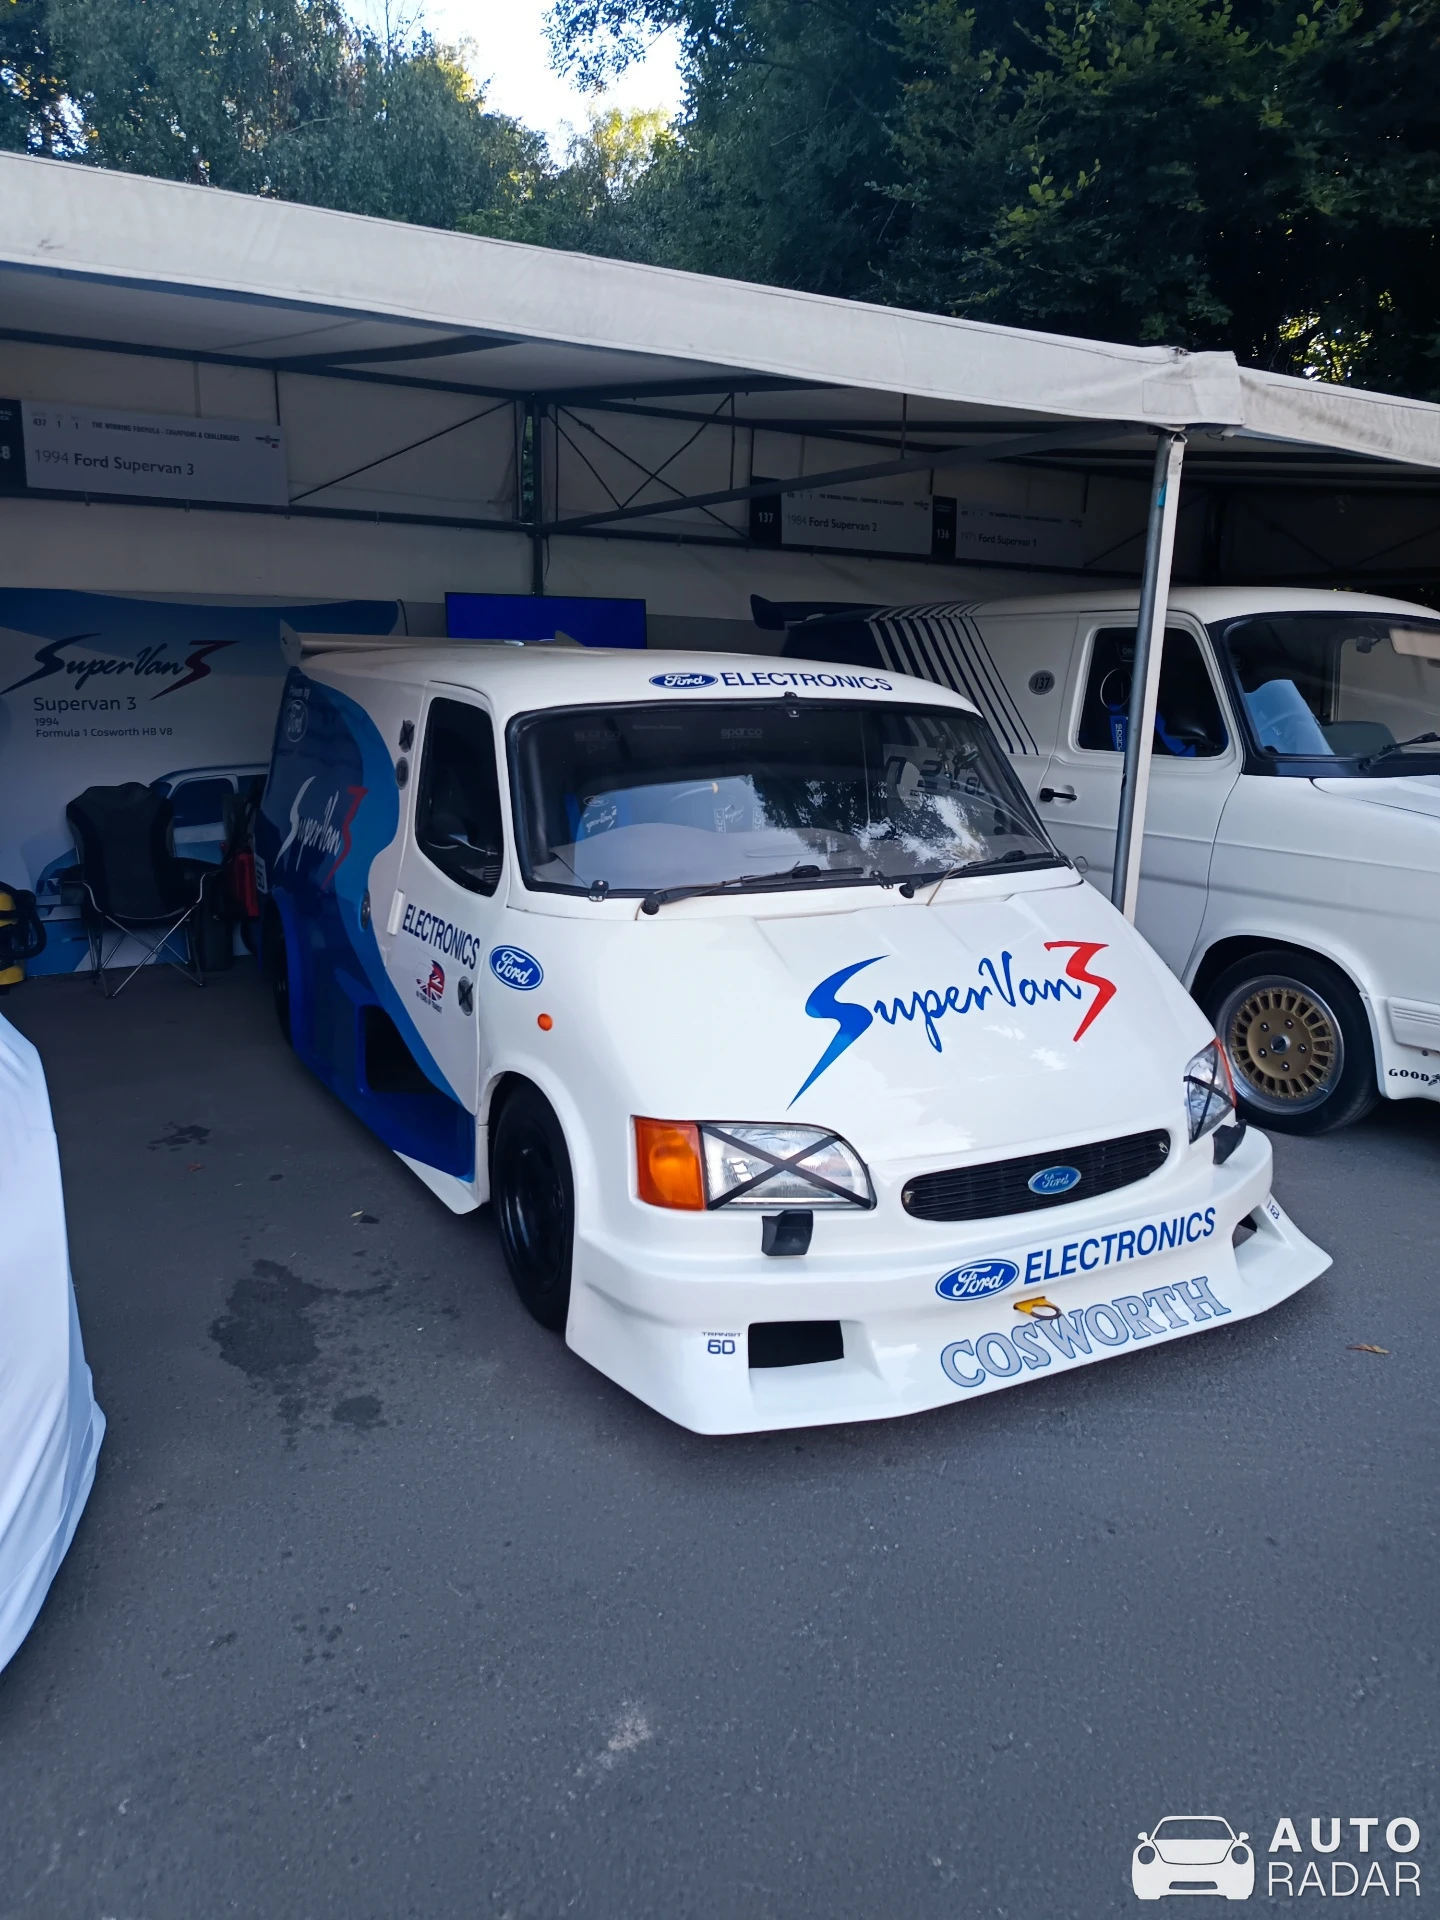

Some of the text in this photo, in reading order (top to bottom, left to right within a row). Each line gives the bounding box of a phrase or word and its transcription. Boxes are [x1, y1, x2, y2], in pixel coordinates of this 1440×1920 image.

[35, 449, 195, 476] 1994 Ford Supervan 3
[758, 512, 774, 523] 137
[810, 516, 829, 528] Ford
[832, 519, 869, 533] Supervan
[872, 522, 878, 532] 2
[979, 533, 996, 545] Ford
[998, 536, 1031, 548] Supervan
[658, 672, 893, 691] Ford ELECTRONICS
[1034, 677, 1051, 690] 137
[34, 697, 137, 714] Supervan 3
[35, 717, 60, 727] 1994
[36, 728, 80, 739] Formula
[91, 727, 139, 738] Cosworth
[143, 726, 157, 737] HB
[160, 726, 173, 736] V8
[402, 903, 480, 970] ELECTRONICS
[494, 949, 536, 987] Ford
[948, 1207, 1216, 1298] Ford ELECTRONICS
[940, 1276, 1232, 1389] COSWORTH
[707, 1339, 736, 1355] 60
